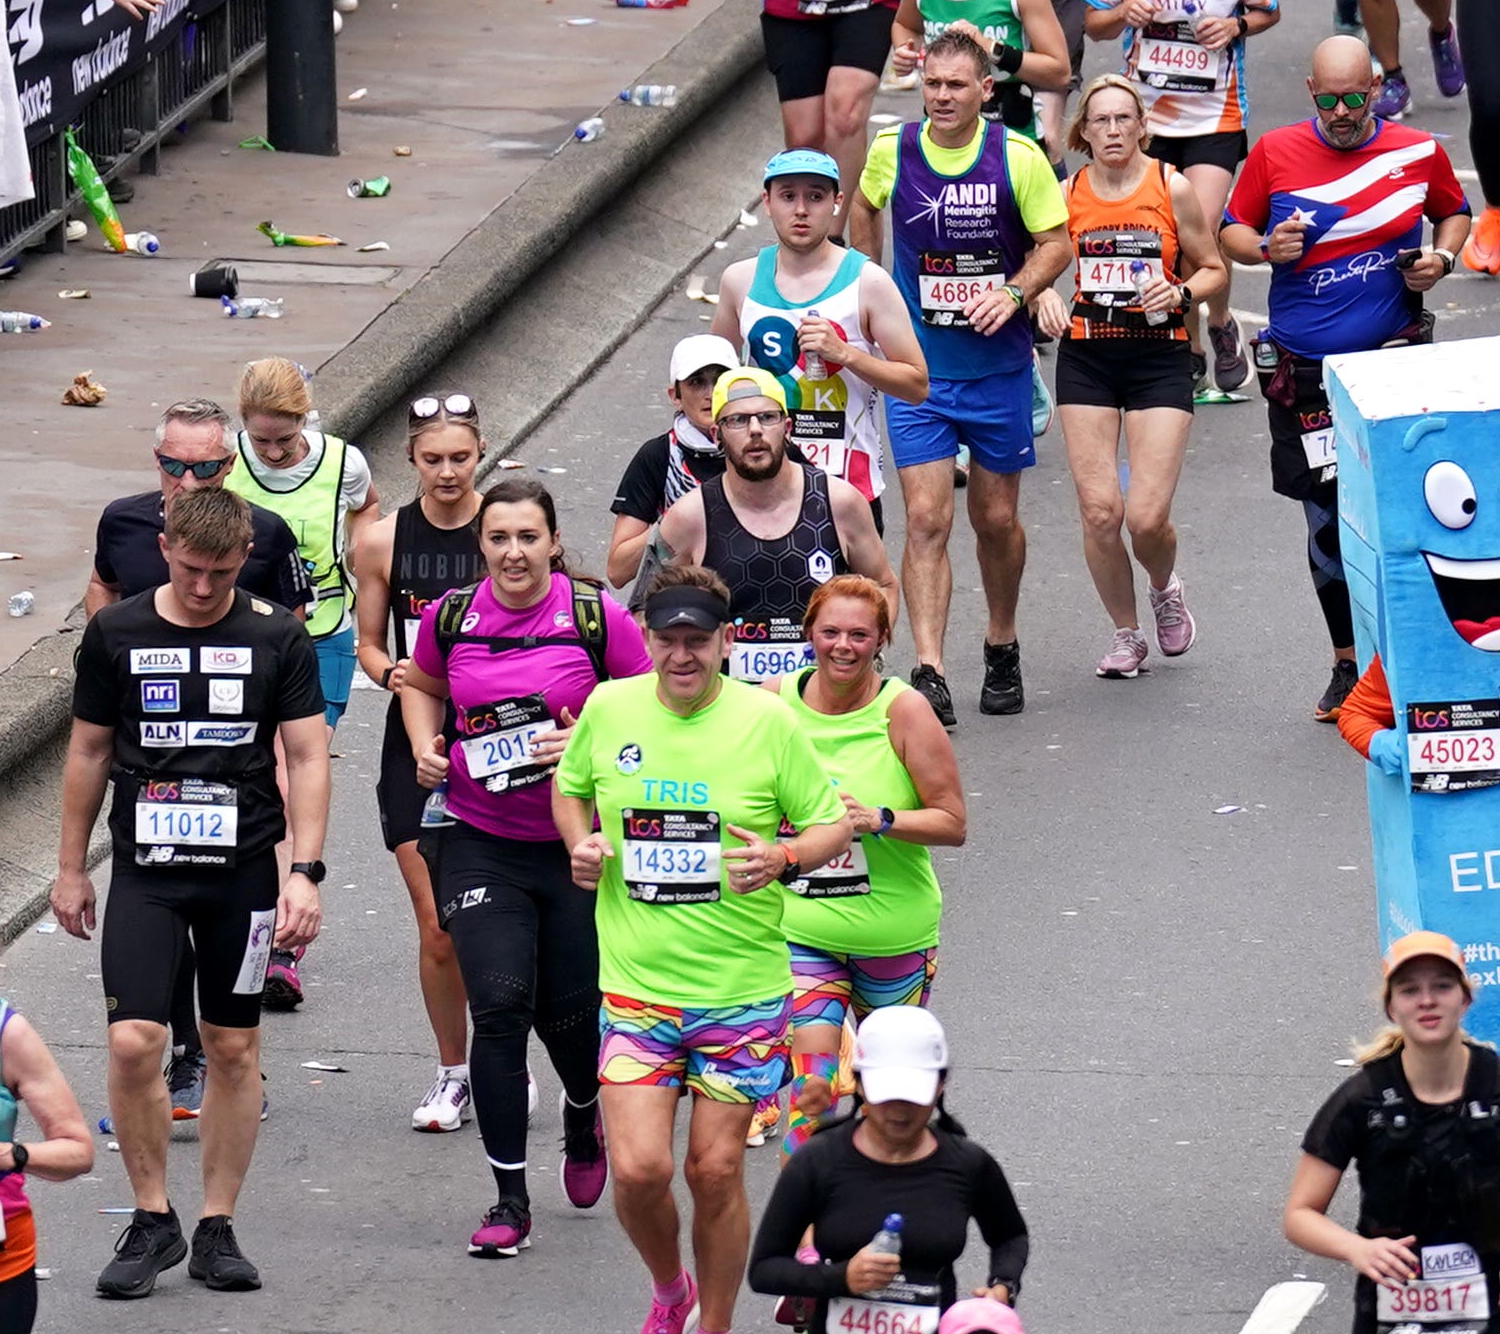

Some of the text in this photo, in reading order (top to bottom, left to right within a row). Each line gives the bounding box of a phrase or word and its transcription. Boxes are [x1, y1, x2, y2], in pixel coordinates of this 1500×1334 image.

[1149, 46, 1208, 70] 44499
[946, 183, 997, 206] ANDI
[945, 204, 997, 218] Meningitis
[945, 218, 991, 229] Research
[947, 228, 998, 240] Foundation
[762, 331, 782, 357] S
[814, 387, 838, 411] K
[138, 652, 182, 667] MIDA
[145, 683, 175, 702] nri
[1452, 704, 1473, 712] TATA
[1452, 710, 1500, 720] CONSULTANCY
[1415, 708, 1449, 728] tcs
[1452, 718, 1483, 727] SERVICES
[1420, 736, 1496, 765] 45023
[147, 779, 179, 800] tcs
[181, 784, 232, 795] CONSULTANCY
[181, 792, 213, 801] SERVICES
[642, 780, 709, 806] TRIS
[148, 813, 223, 838] 11012
[633, 816, 660, 835] tcs
[663, 822, 713, 831] CONSULTANCY
[663, 829, 697, 838] SERVICES
[632, 847, 708, 873] 14332
[1389, 1284, 1472, 1314] 39817
